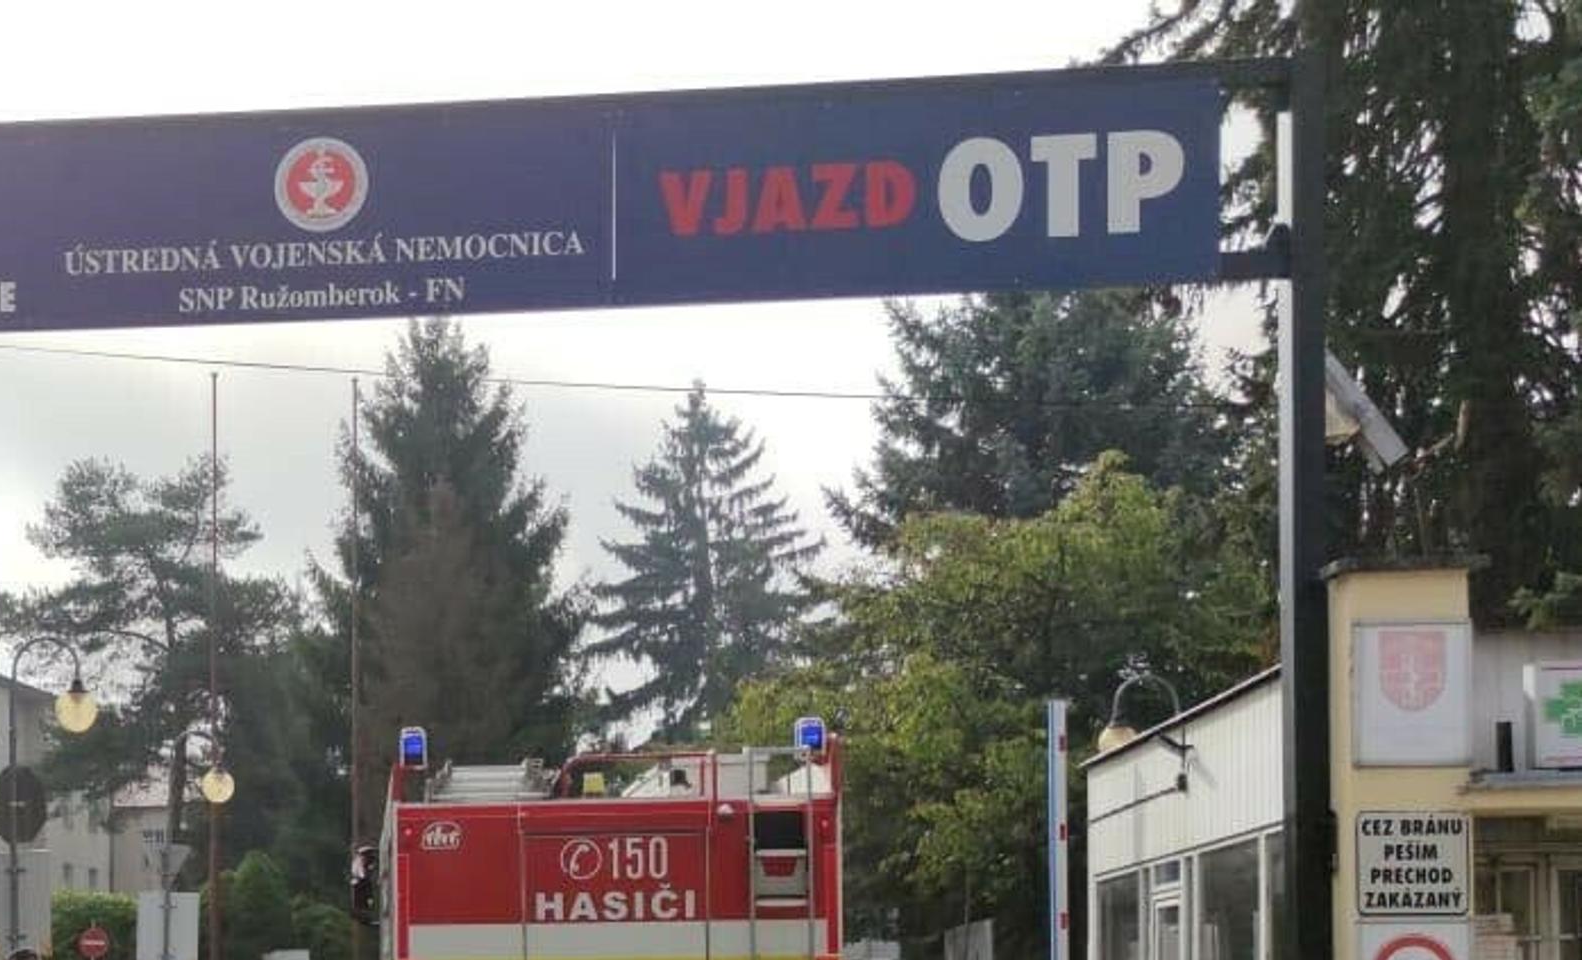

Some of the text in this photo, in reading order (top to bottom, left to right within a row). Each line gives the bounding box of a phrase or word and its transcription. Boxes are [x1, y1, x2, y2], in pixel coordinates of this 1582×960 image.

[659, 130, 1185, 242] VJAZD OTP
[65, 231, 586, 275] ÚSTREDNÁ VOJENSKÁ NEMOCNICA
[178, 288, 234, 313] SNP
[240, 282, 401, 309] Ružomberok
[426, 276, 465, 303] FN
[1361, 814, 1463, 837] CEZ BRÁNU
[608, 836, 668, 880] 150
[1370, 866, 1453, 885] PRECHOD
[535, 883, 696, 921] HASIČI
